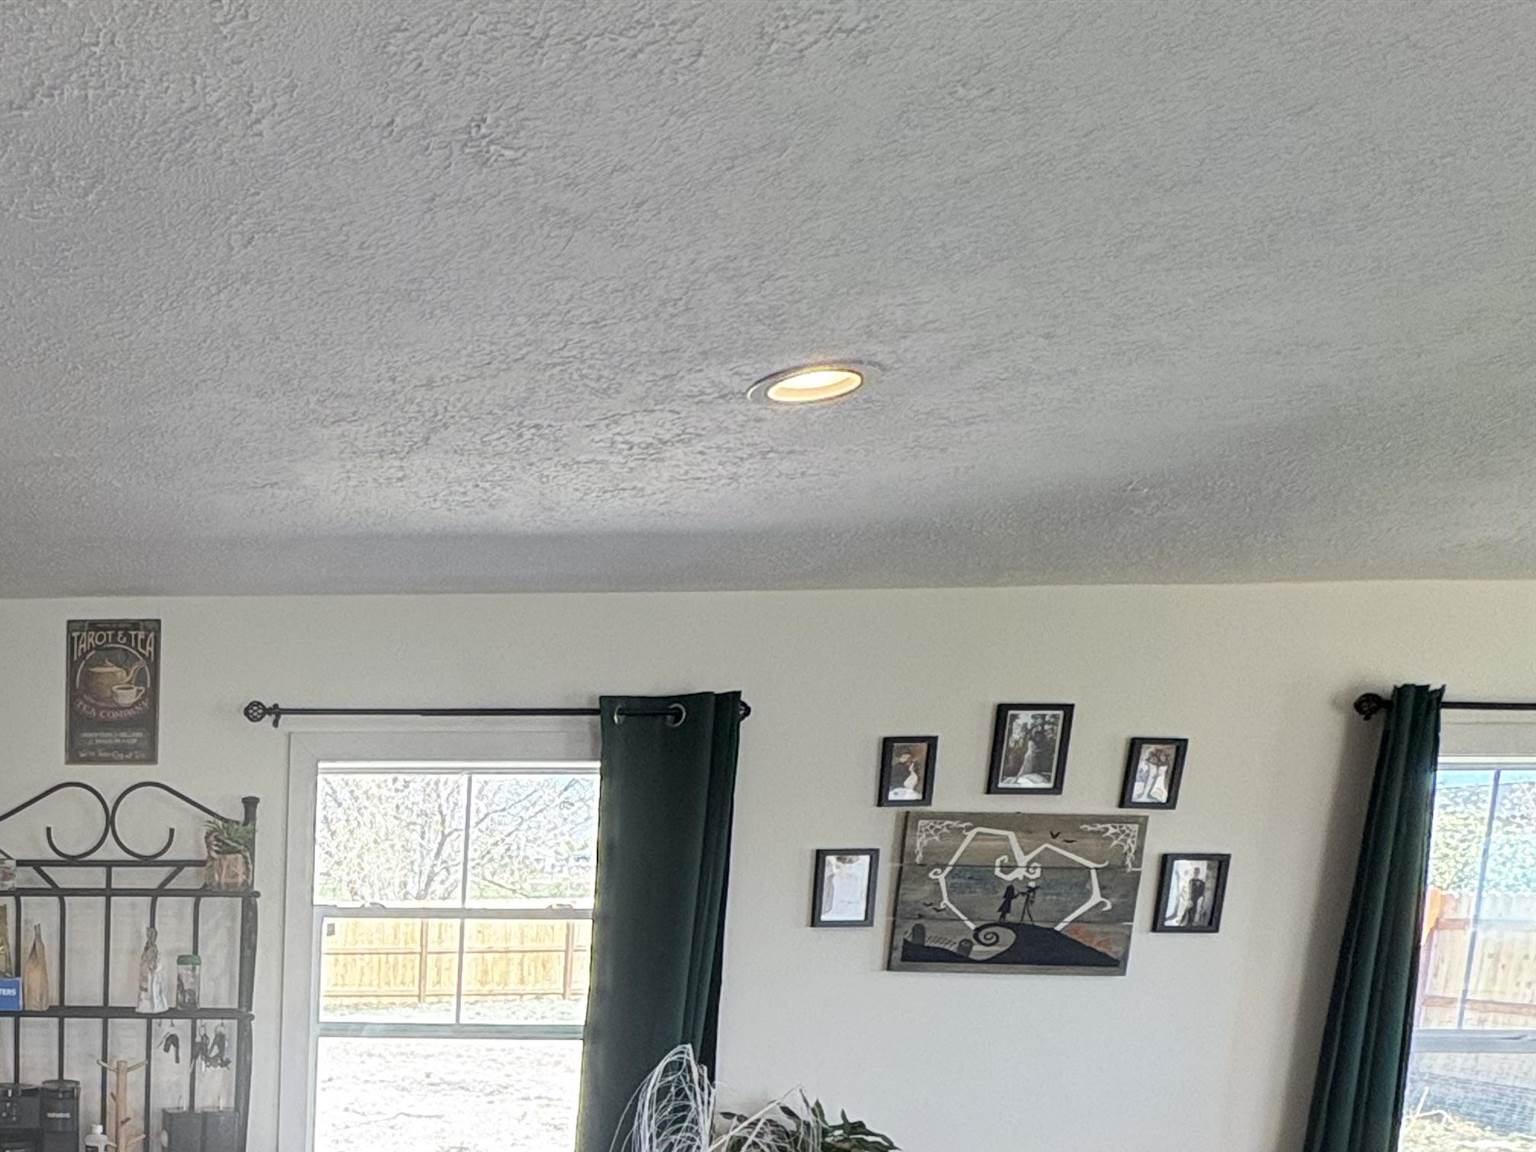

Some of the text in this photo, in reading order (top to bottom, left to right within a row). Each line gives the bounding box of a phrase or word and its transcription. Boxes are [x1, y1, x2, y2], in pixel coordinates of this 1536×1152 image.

[72, 631, 155, 663] TAROT & TEA
[76, 701, 96, 717] TEA
